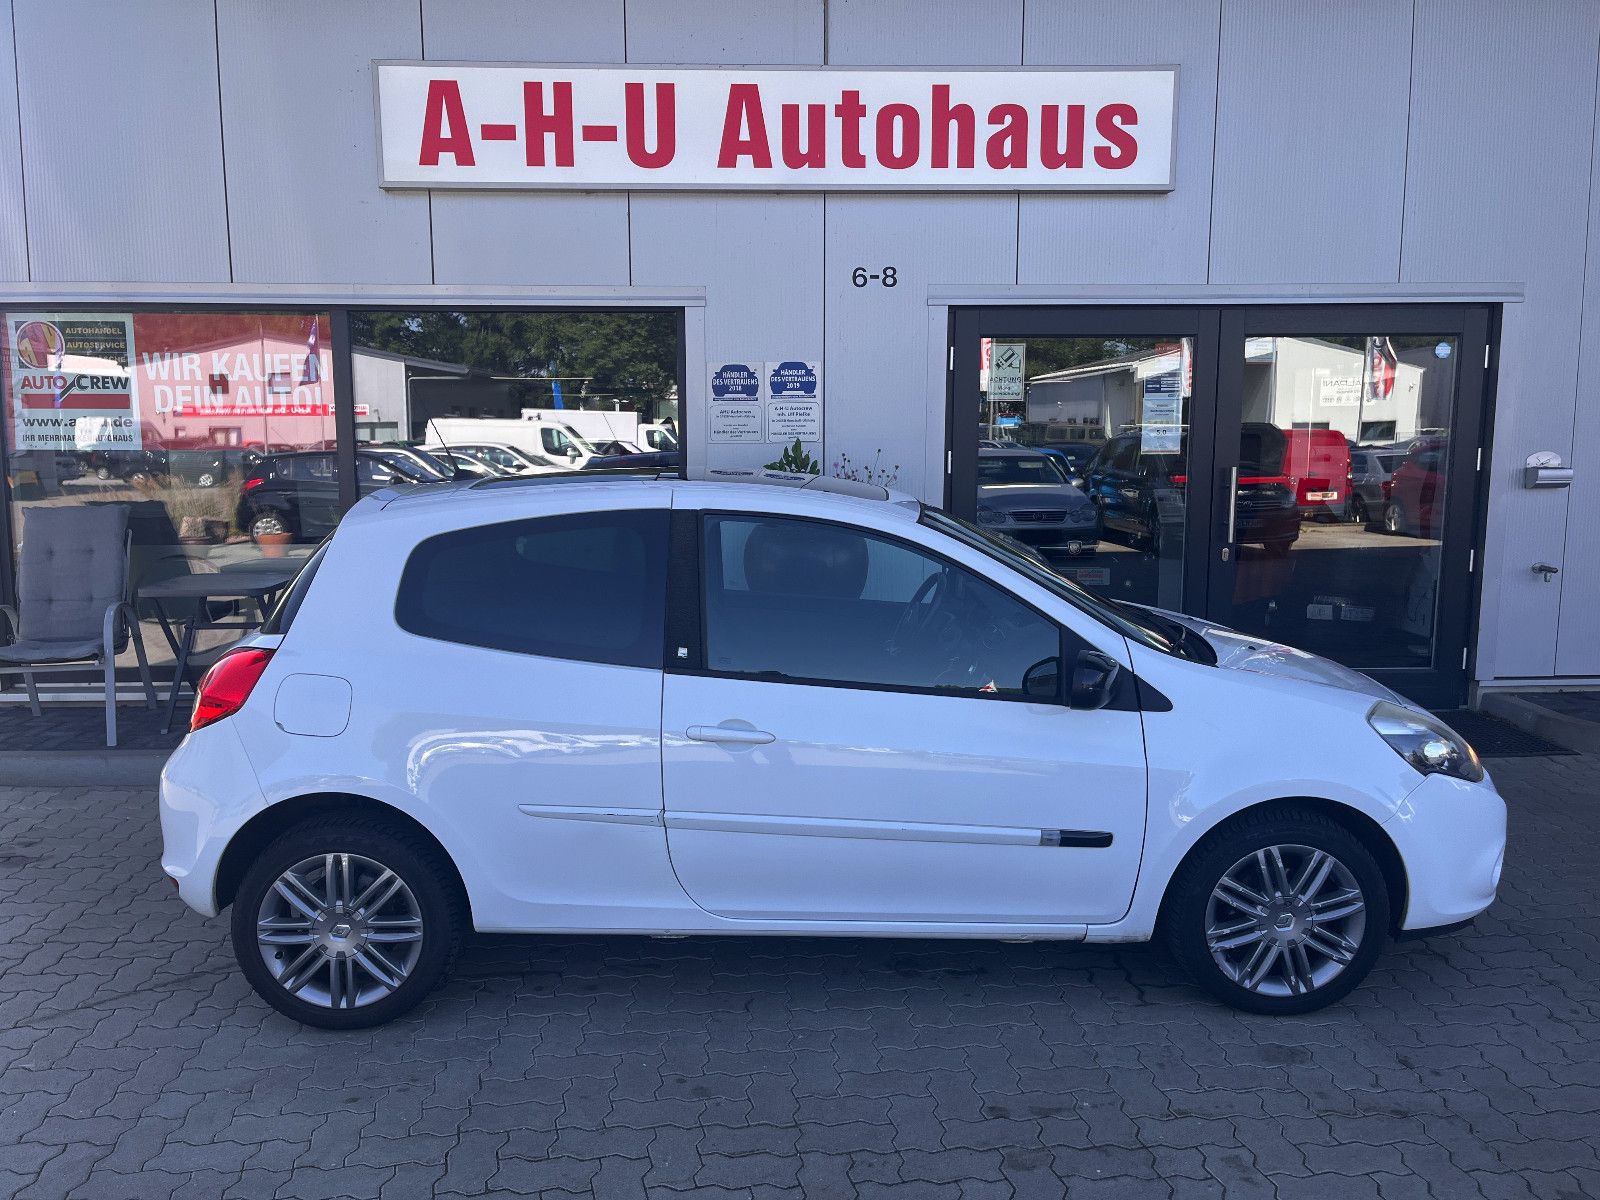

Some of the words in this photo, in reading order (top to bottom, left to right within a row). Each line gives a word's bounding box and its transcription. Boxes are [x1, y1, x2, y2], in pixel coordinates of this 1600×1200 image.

[418, 79, 676, 169] A-H-U
[717, 83, 1138, 170] Autohaus
[852, 266, 897, 288] 6-8
[65, 326, 123, 335] AUTOHANDEL
[142, 351, 203, 382] WIR
[211, 352, 329, 383] KAUFEN
[722, 370, 748, 378] HÄNDLER
[20, 375, 68, 390] AUTO
[76, 374, 129, 390] CREW
[723, 378, 758, 386] VERTRAUENS
[153, 384, 225, 413] DEIN
[22, 434, 36, 442] IHR
